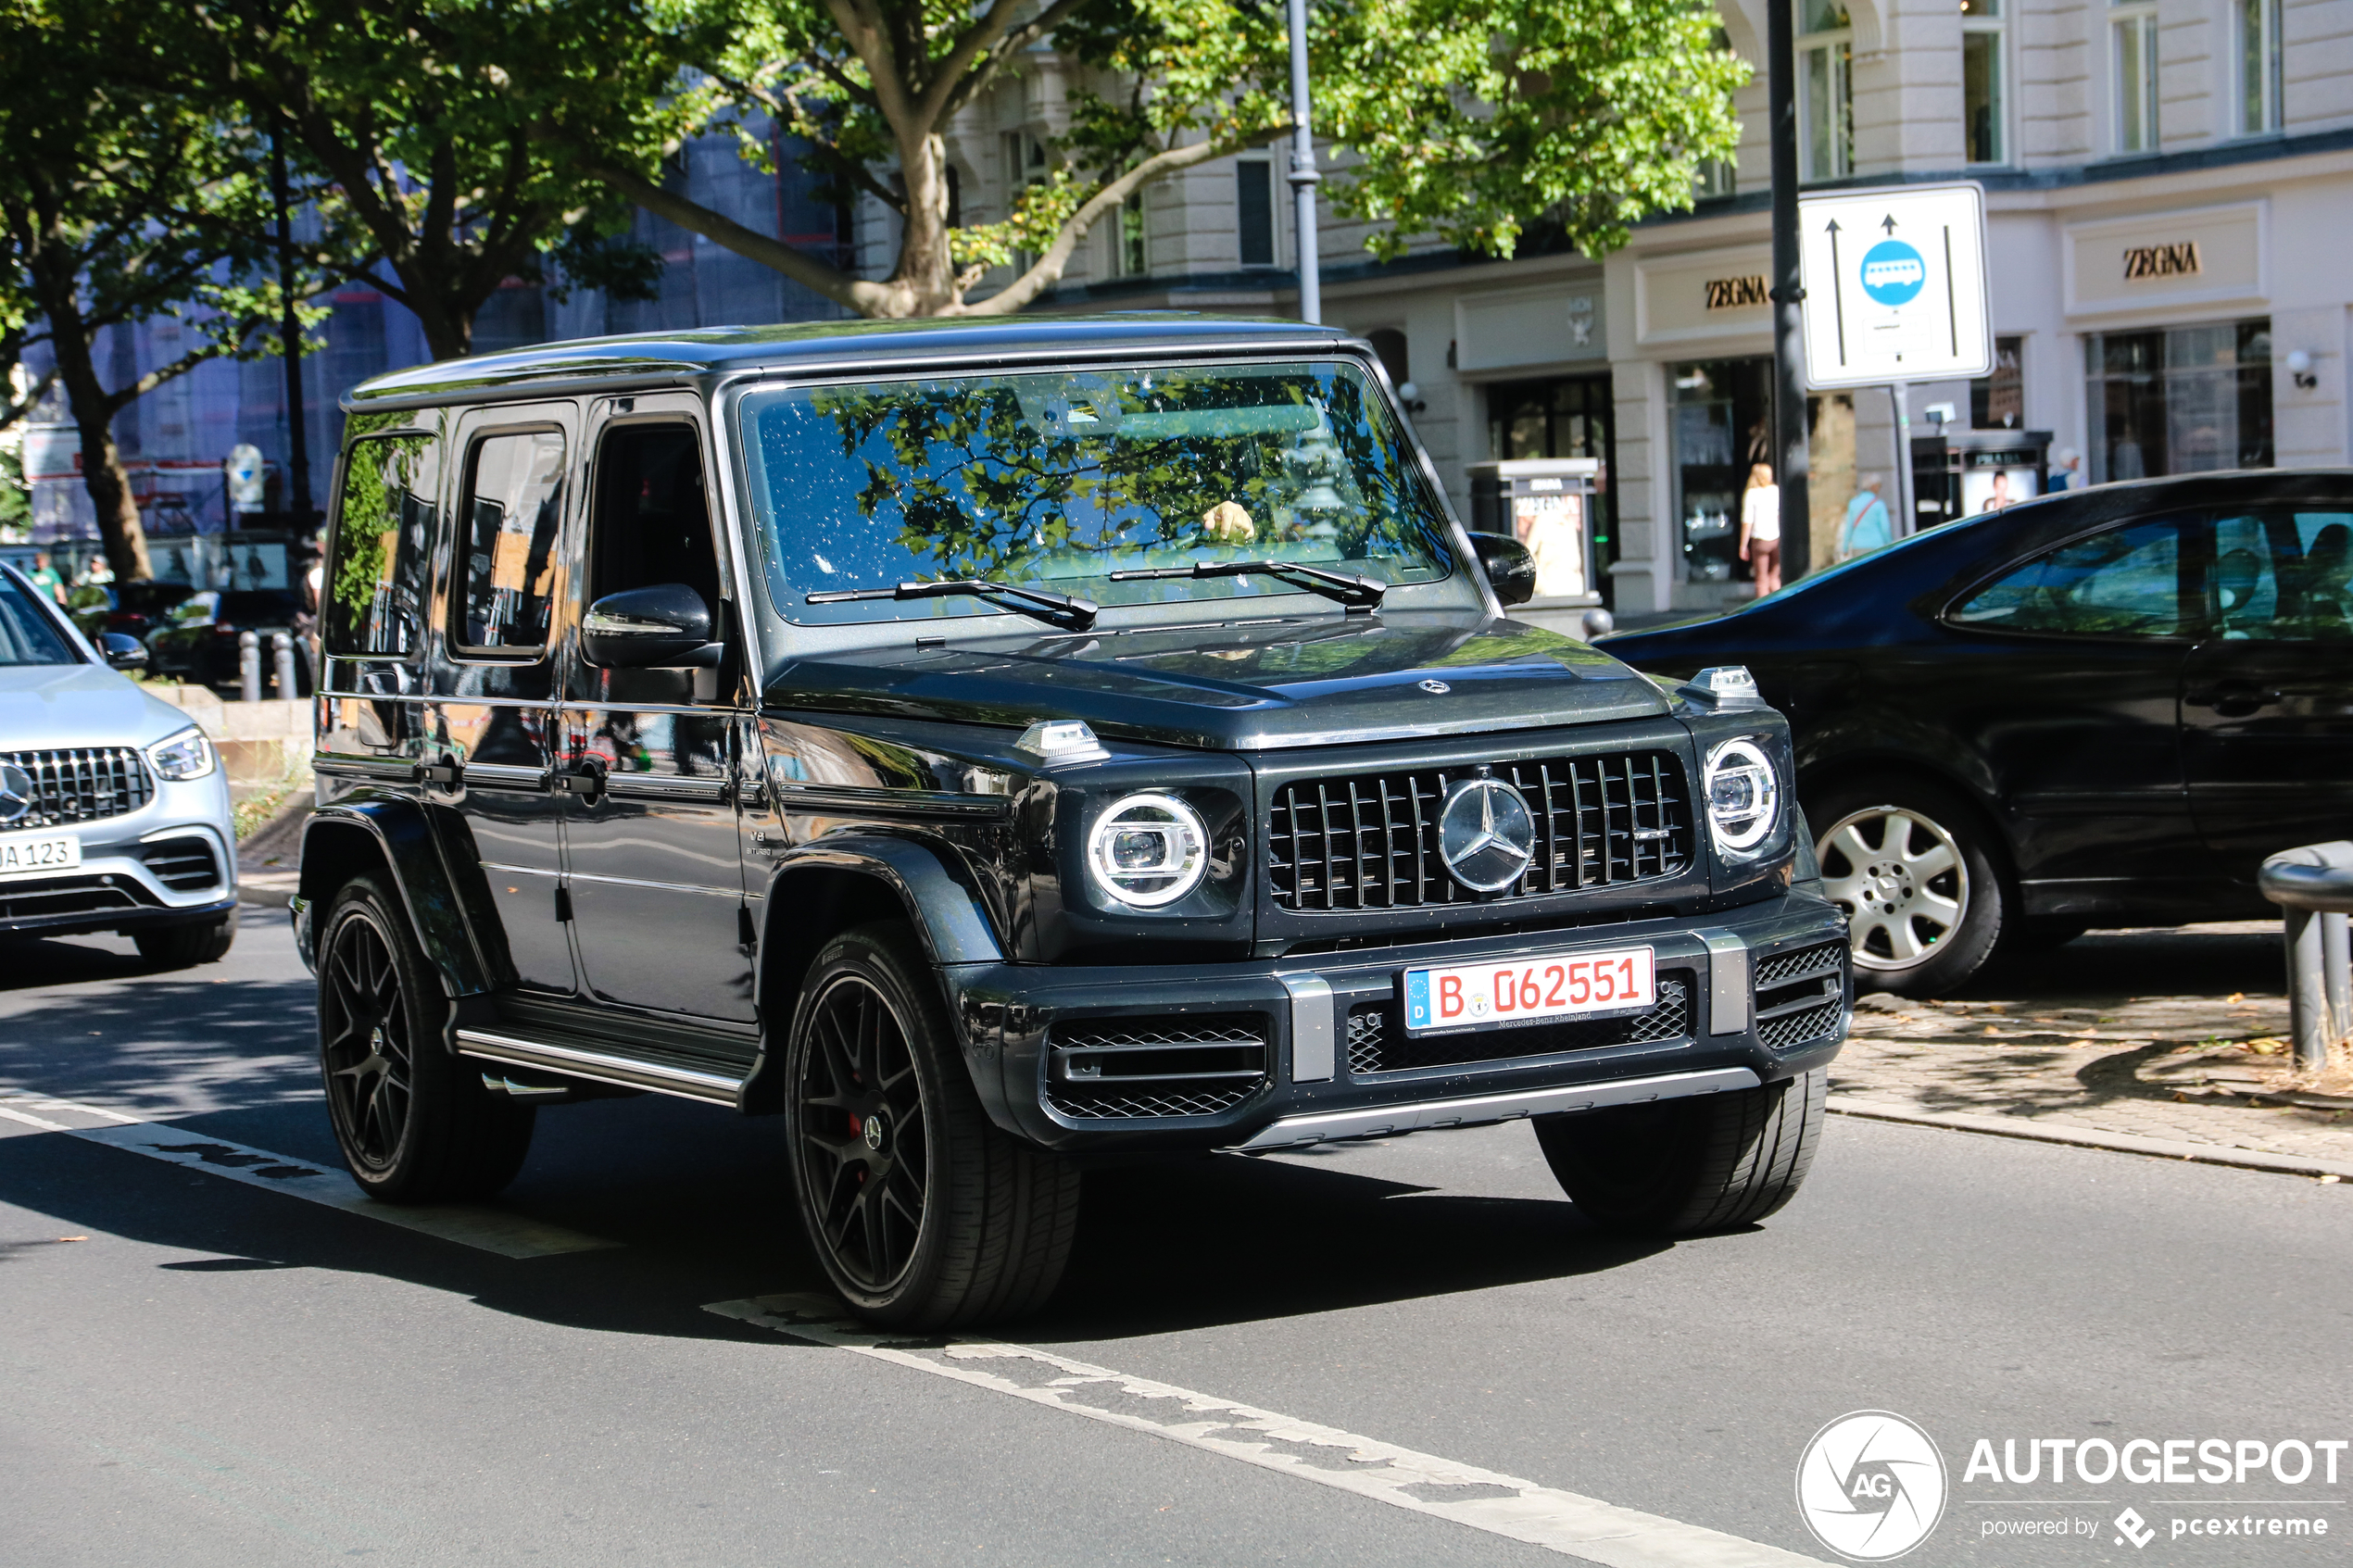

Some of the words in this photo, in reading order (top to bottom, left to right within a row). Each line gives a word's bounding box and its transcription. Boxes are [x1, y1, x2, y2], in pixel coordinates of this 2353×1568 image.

[2124, 242, 2198, 279] ZEGNA
[1705, 275, 1767, 309] ZEGNA
[750, 831, 765, 842] V8
[25, 841, 68, 866] 123
[746, 847, 772, 856] BITURBO
[1440, 975, 1465, 1018] B
[1493, 958, 1640, 1012] 062551
[1415, 1005, 1424, 1019] D
[1498, 1016, 1554, 1029] Mercedes-Benz
[1554, 1011, 1592, 1022] Rheinland
